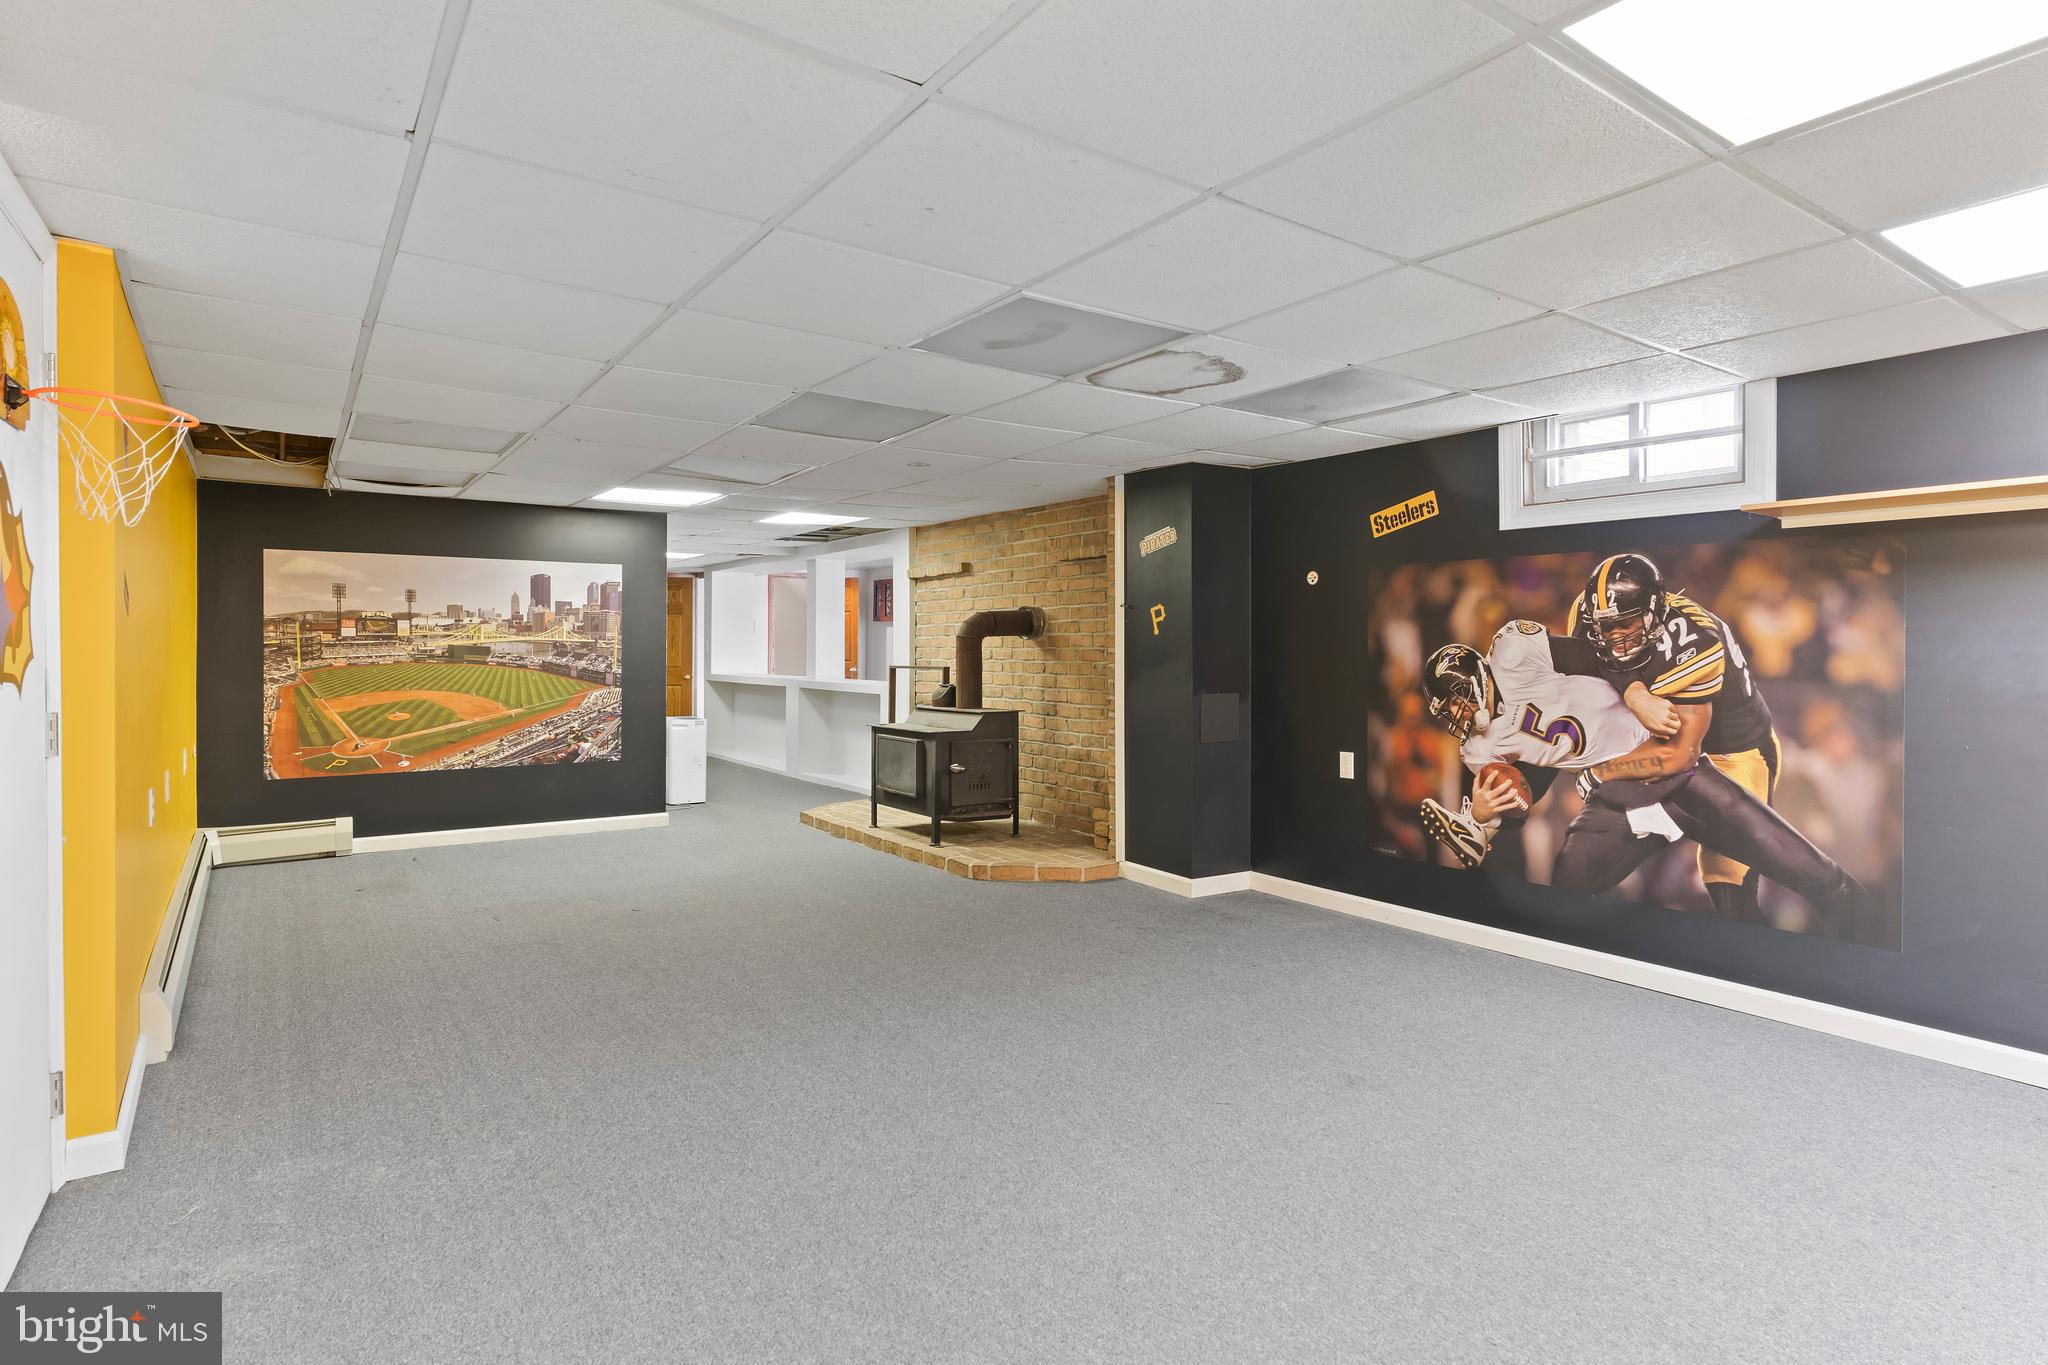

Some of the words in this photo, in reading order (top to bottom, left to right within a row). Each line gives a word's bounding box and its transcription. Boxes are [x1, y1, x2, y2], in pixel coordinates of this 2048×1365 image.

[1373, 499, 1435, 534] Steelers
[1140, 530, 1177, 557] PIRATES
[1592, 590, 1618, 610] 92
[1150, 603, 1166, 636] P
[1655, 616, 1699, 661] 92
[1519, 702, 1587, 757] 5
[325, 759, 348, 770] P
